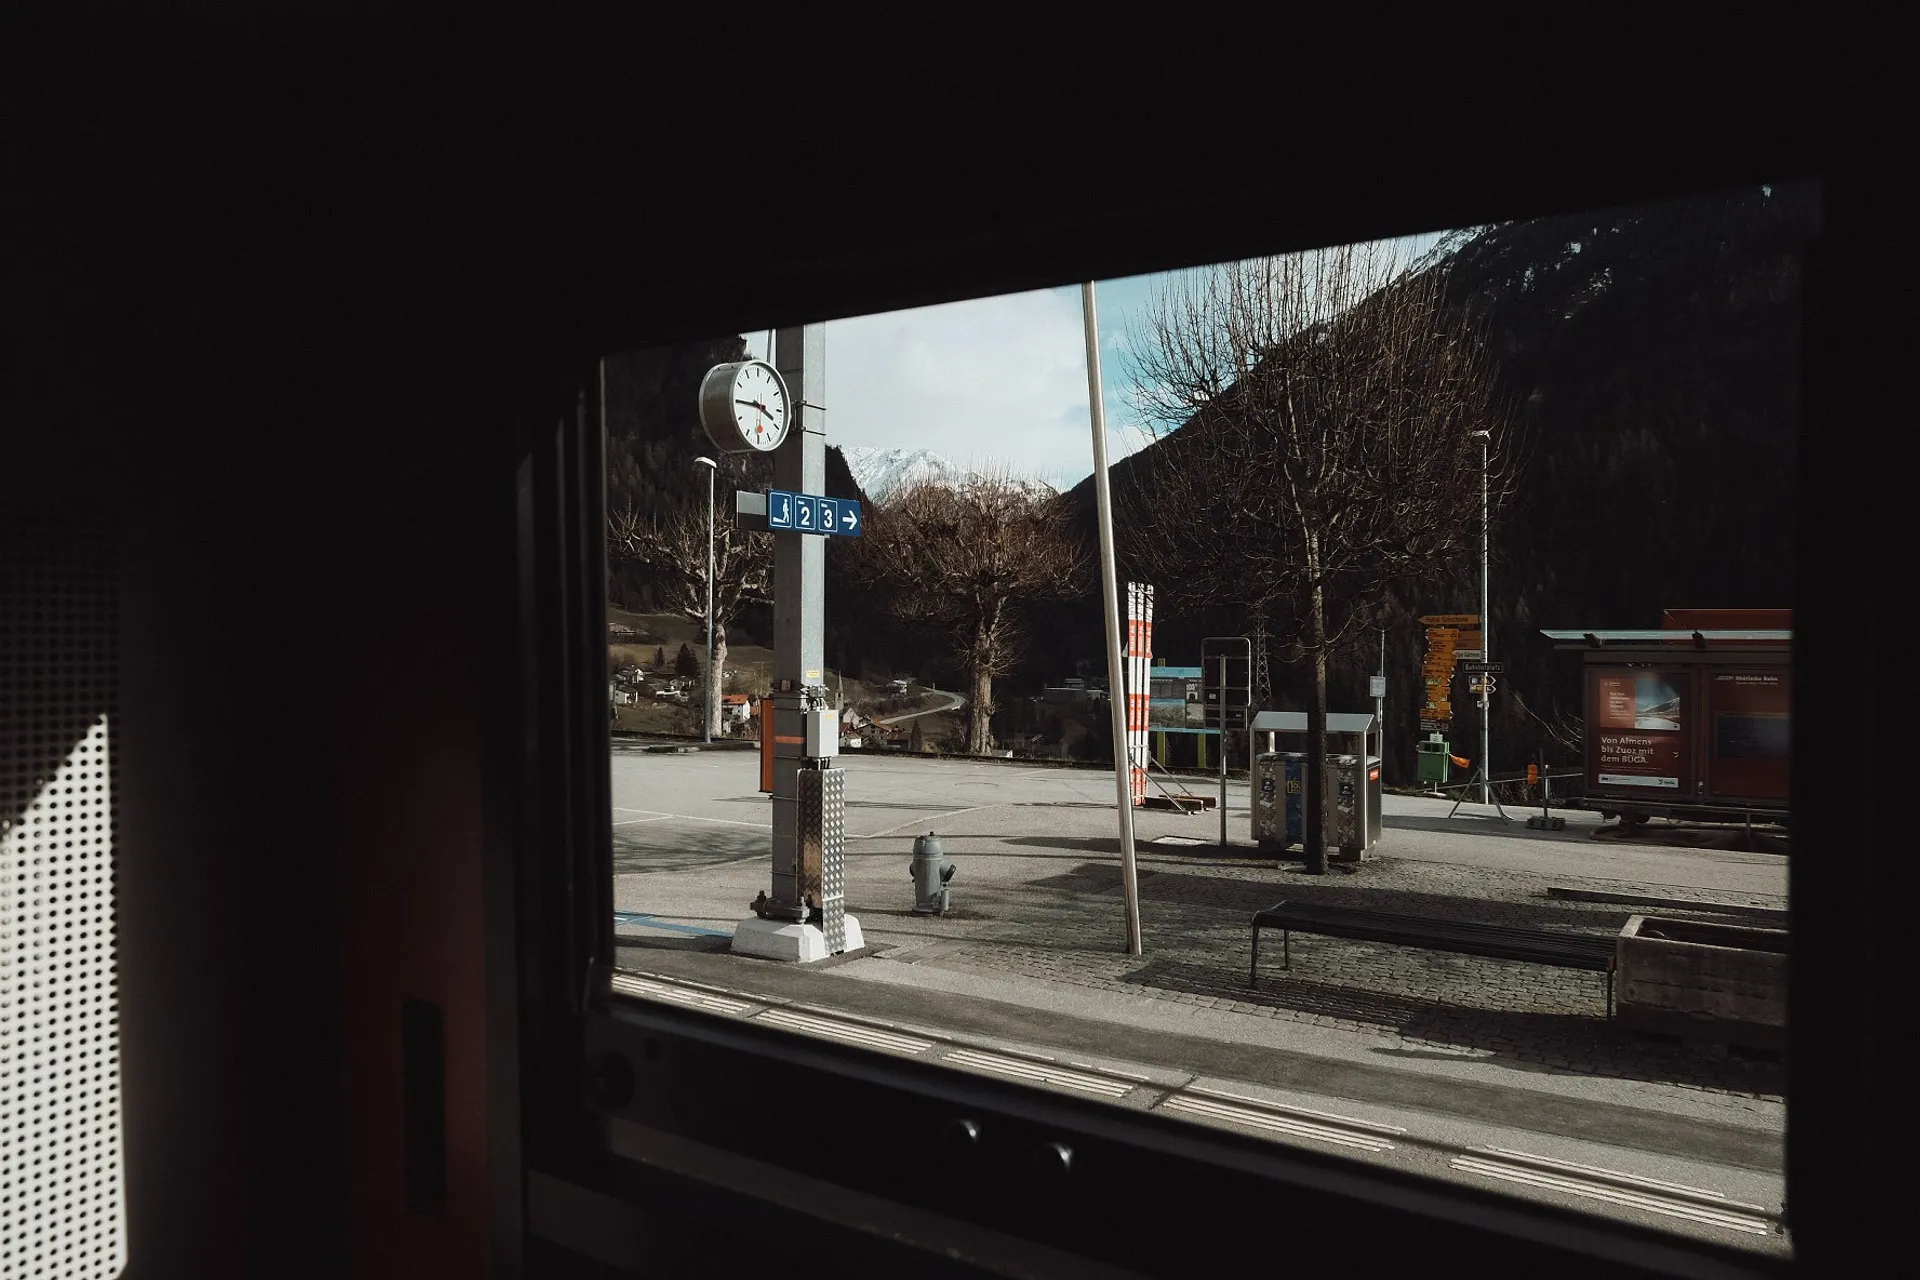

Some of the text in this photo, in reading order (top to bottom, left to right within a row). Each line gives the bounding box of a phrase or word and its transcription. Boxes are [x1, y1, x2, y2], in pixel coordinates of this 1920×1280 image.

[801, 506, 833, 528] 2 3
[1465, 663, 1500, 671] Bahnhofplatz
[1619, 737, 1652, 745] Almens
[1601, 745, 1654, 755] bis Zuoz mit
[1601, 754, 1649, 764] dem BÜGA.
